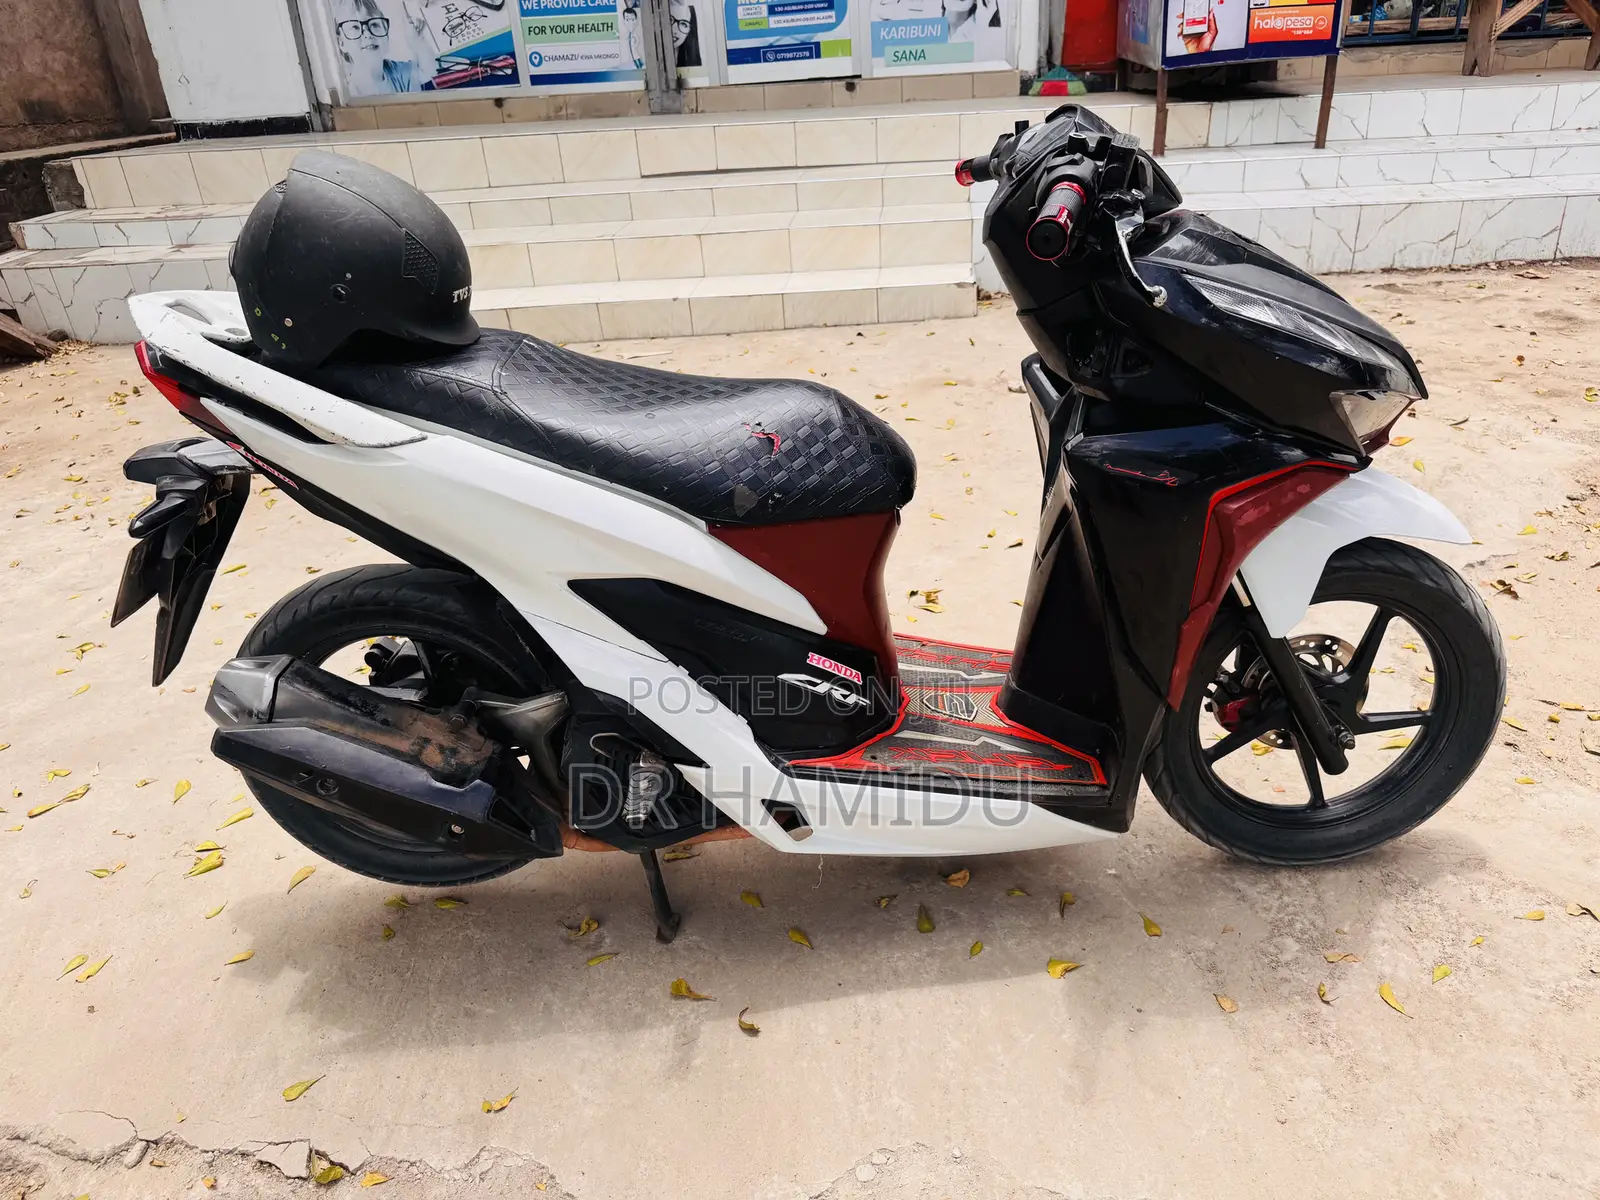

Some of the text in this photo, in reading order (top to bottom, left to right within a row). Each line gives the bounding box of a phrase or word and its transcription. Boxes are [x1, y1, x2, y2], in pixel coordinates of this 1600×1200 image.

[522, 0, 539, 10] WE
[541, 0, 586, 9] PROVIDE
[528, 22, 614, 36] FOR YOUR HEALTH
[1254, 15, 1314, 31] halopesa
[880, 24, 942, 40] KARIBUNI
[892, 48, 927, 63] SANA
[807, 652, 862, 684] HONDA
